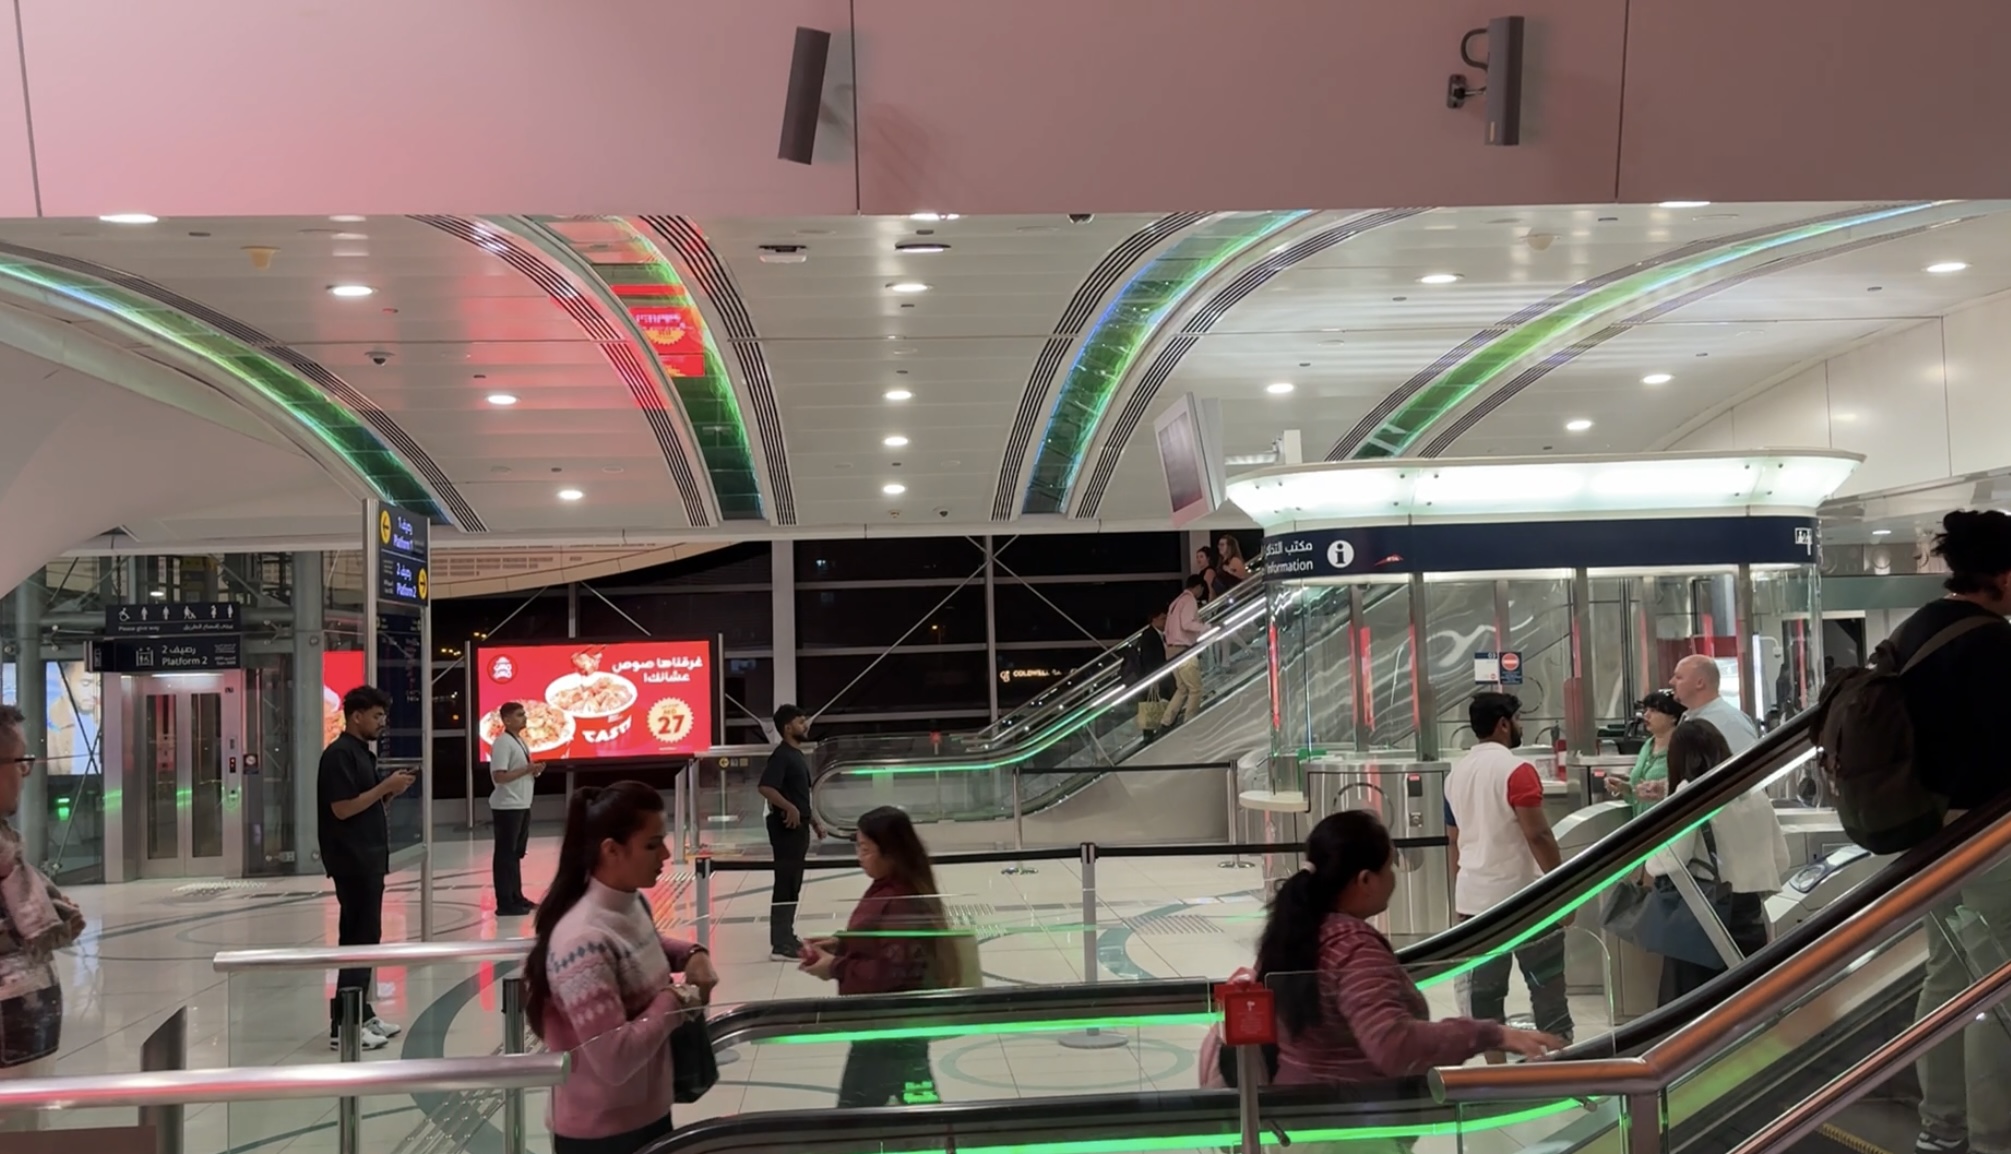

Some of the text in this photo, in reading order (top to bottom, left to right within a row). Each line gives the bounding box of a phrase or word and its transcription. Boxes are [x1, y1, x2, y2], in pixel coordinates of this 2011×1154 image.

[1284, 541, 1313, 556] مكتب
[162, 645, 196, 655] رصيف 2
[162, 657, 200, 666] Platform
[202, 656, 208, 665] 2
[612, 656, 703, 673] غرقناها صوص
[658, 714, 685, 735] 27
